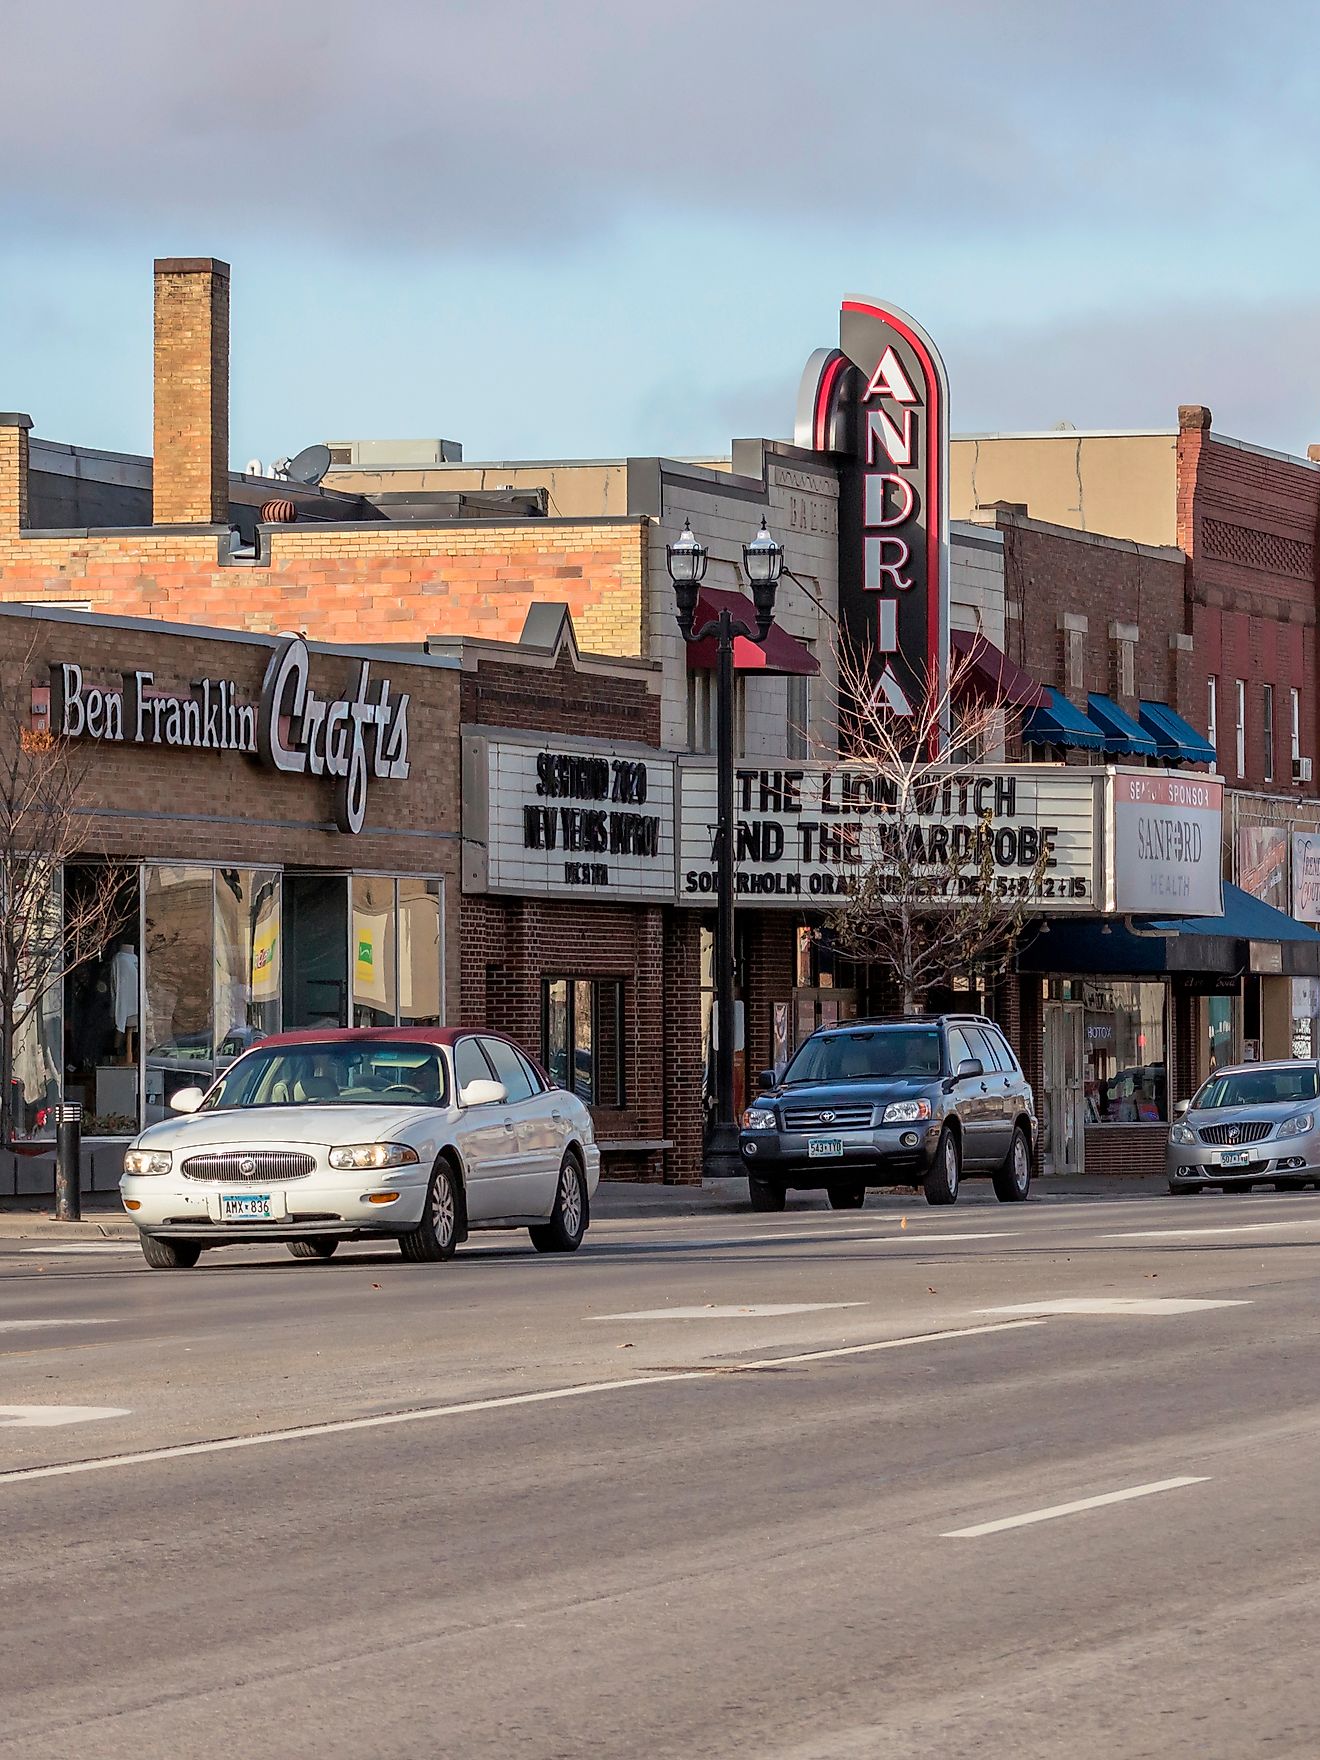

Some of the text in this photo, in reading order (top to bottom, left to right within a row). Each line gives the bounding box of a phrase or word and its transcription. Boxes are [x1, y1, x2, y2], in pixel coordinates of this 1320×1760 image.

[863, 344, 917, 716] ANDRIA
[61, 638, 411, 835] Ben Franklin Crafts
[736, 770, 1016, 818] THE LION WITCH
[797, 821, 863, 865] THE
[877, 823, 1059, 868] WARDROBE
[1138, 817, 1202, 863] SANFORD
[685, 870, 801, 895] SODRHOLM
[958, 875, 992, 898] DE
[1150, 874, 1190, 897] HEALTH
[1087, 1026, 1112, 1039] BOTOX
[250, 1200, 270, 1213] 836
